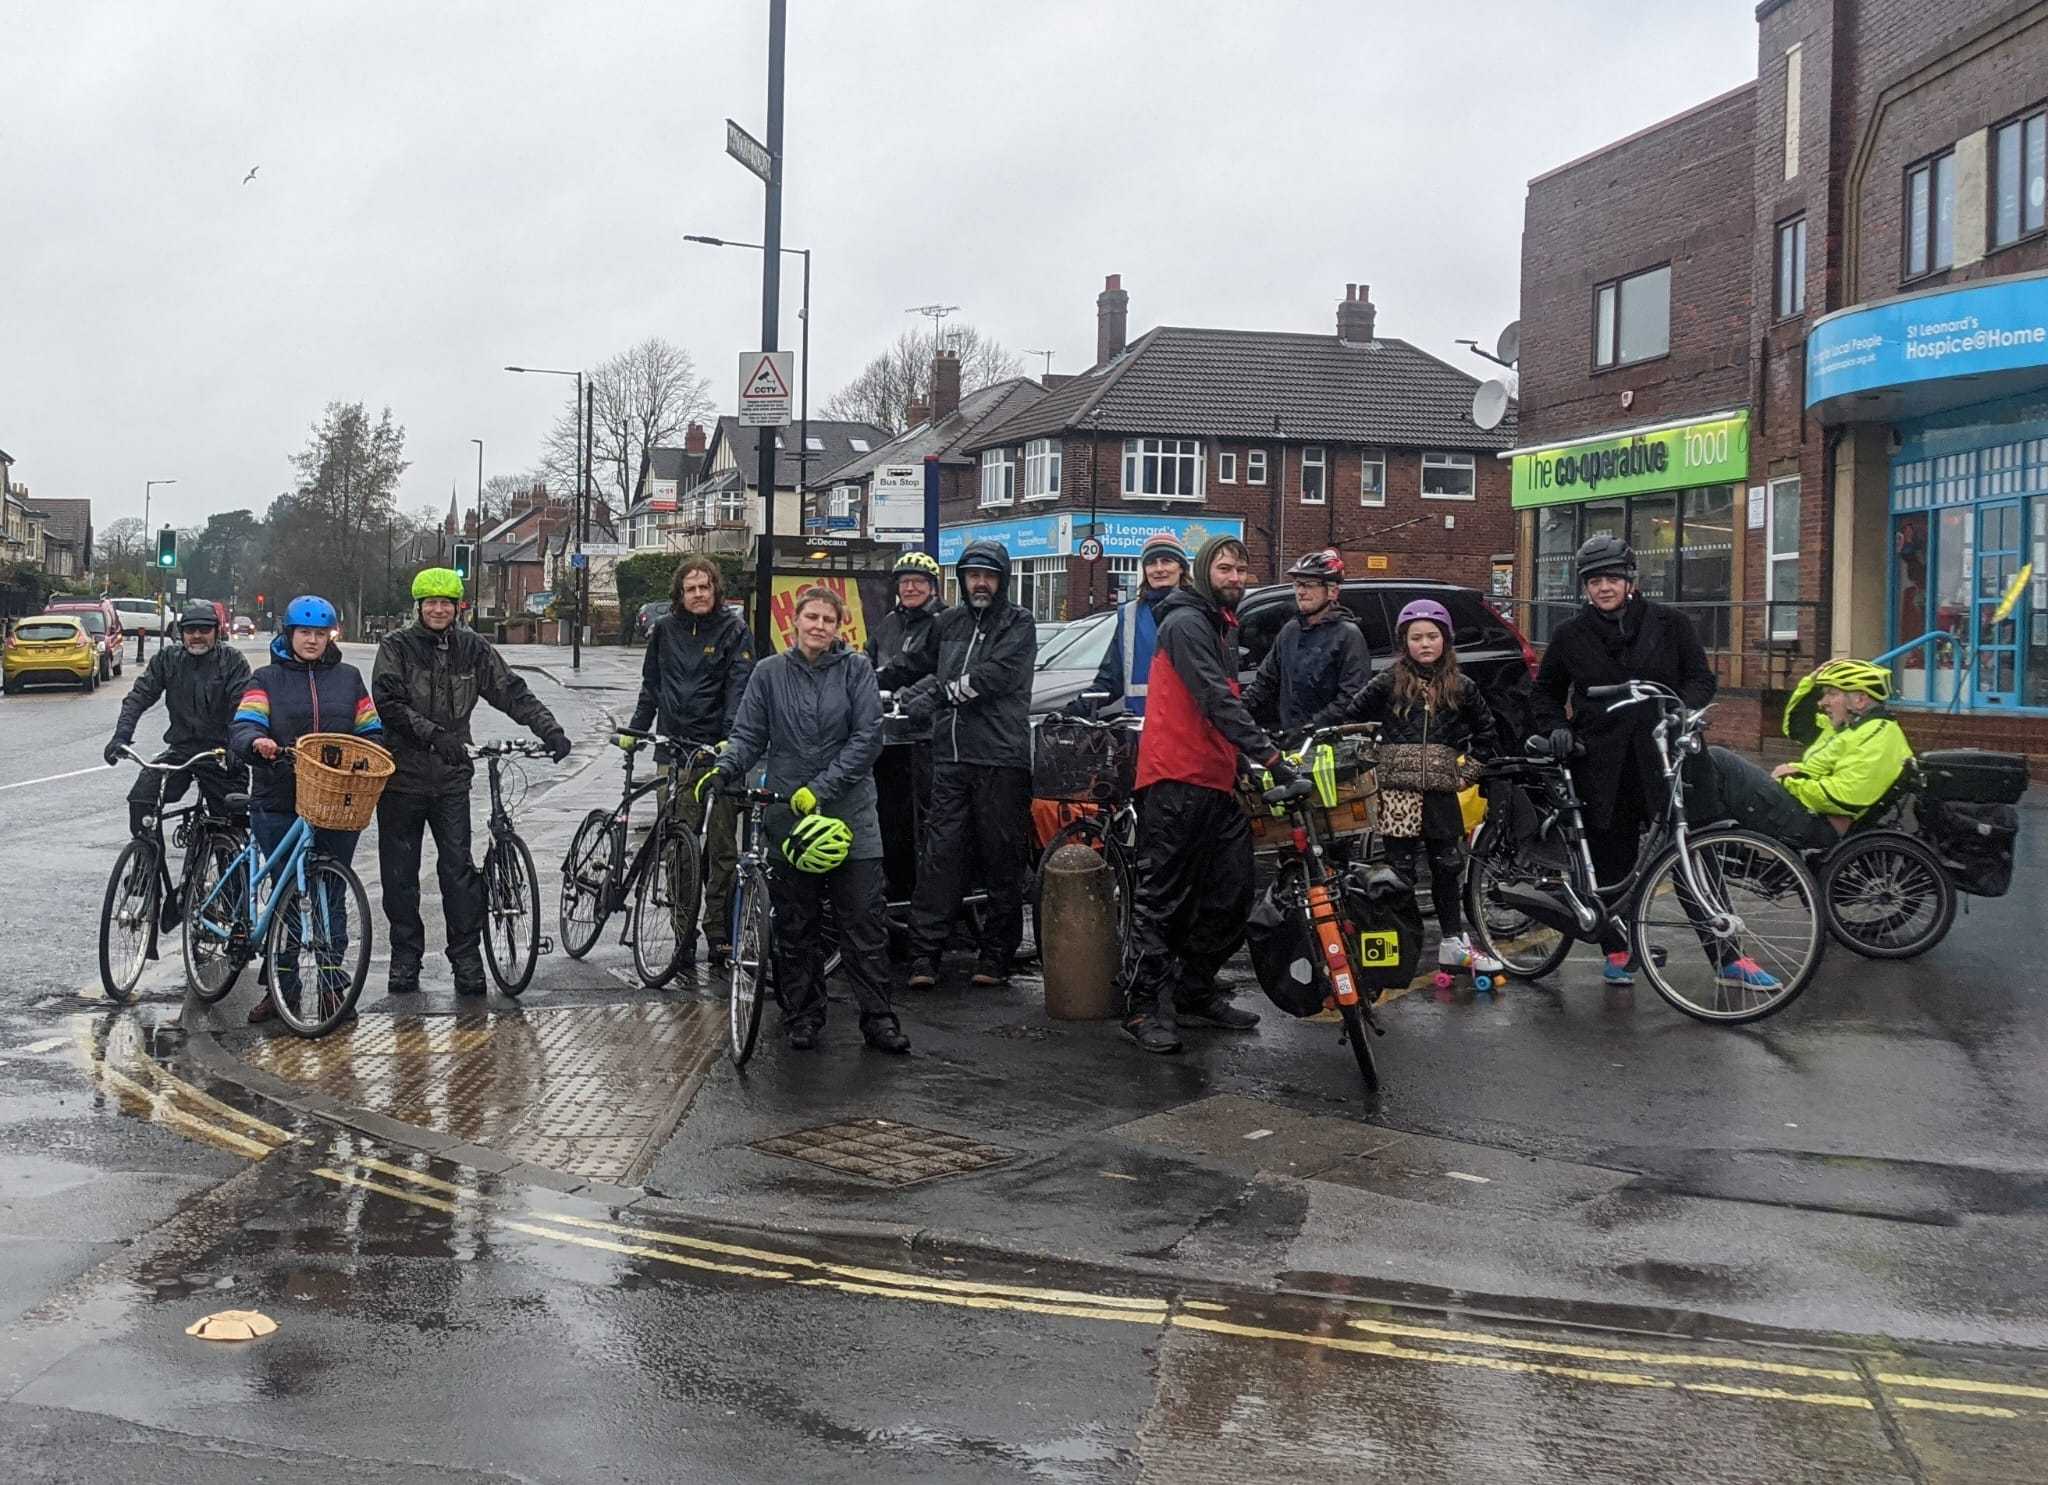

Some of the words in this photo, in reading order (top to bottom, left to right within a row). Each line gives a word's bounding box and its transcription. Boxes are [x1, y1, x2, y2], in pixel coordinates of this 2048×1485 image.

[1919, 315, 1979, 337] Leonard's
[1906, 327, 2046, 360] Hospice@Home
[1528, 454, 1551, 490] The
[1554, 436, 1670, 492] co-operative
[1683, 421, 1728, 468] food
[900, 478, 920, 487] Stop
[1116, 524, 1176, 537] Leonard's
[806, 538, 848, 547] JCDecaux
[1101, 535, 1147, 549] Hospic
[1083, 544, 1098, 555] 20
